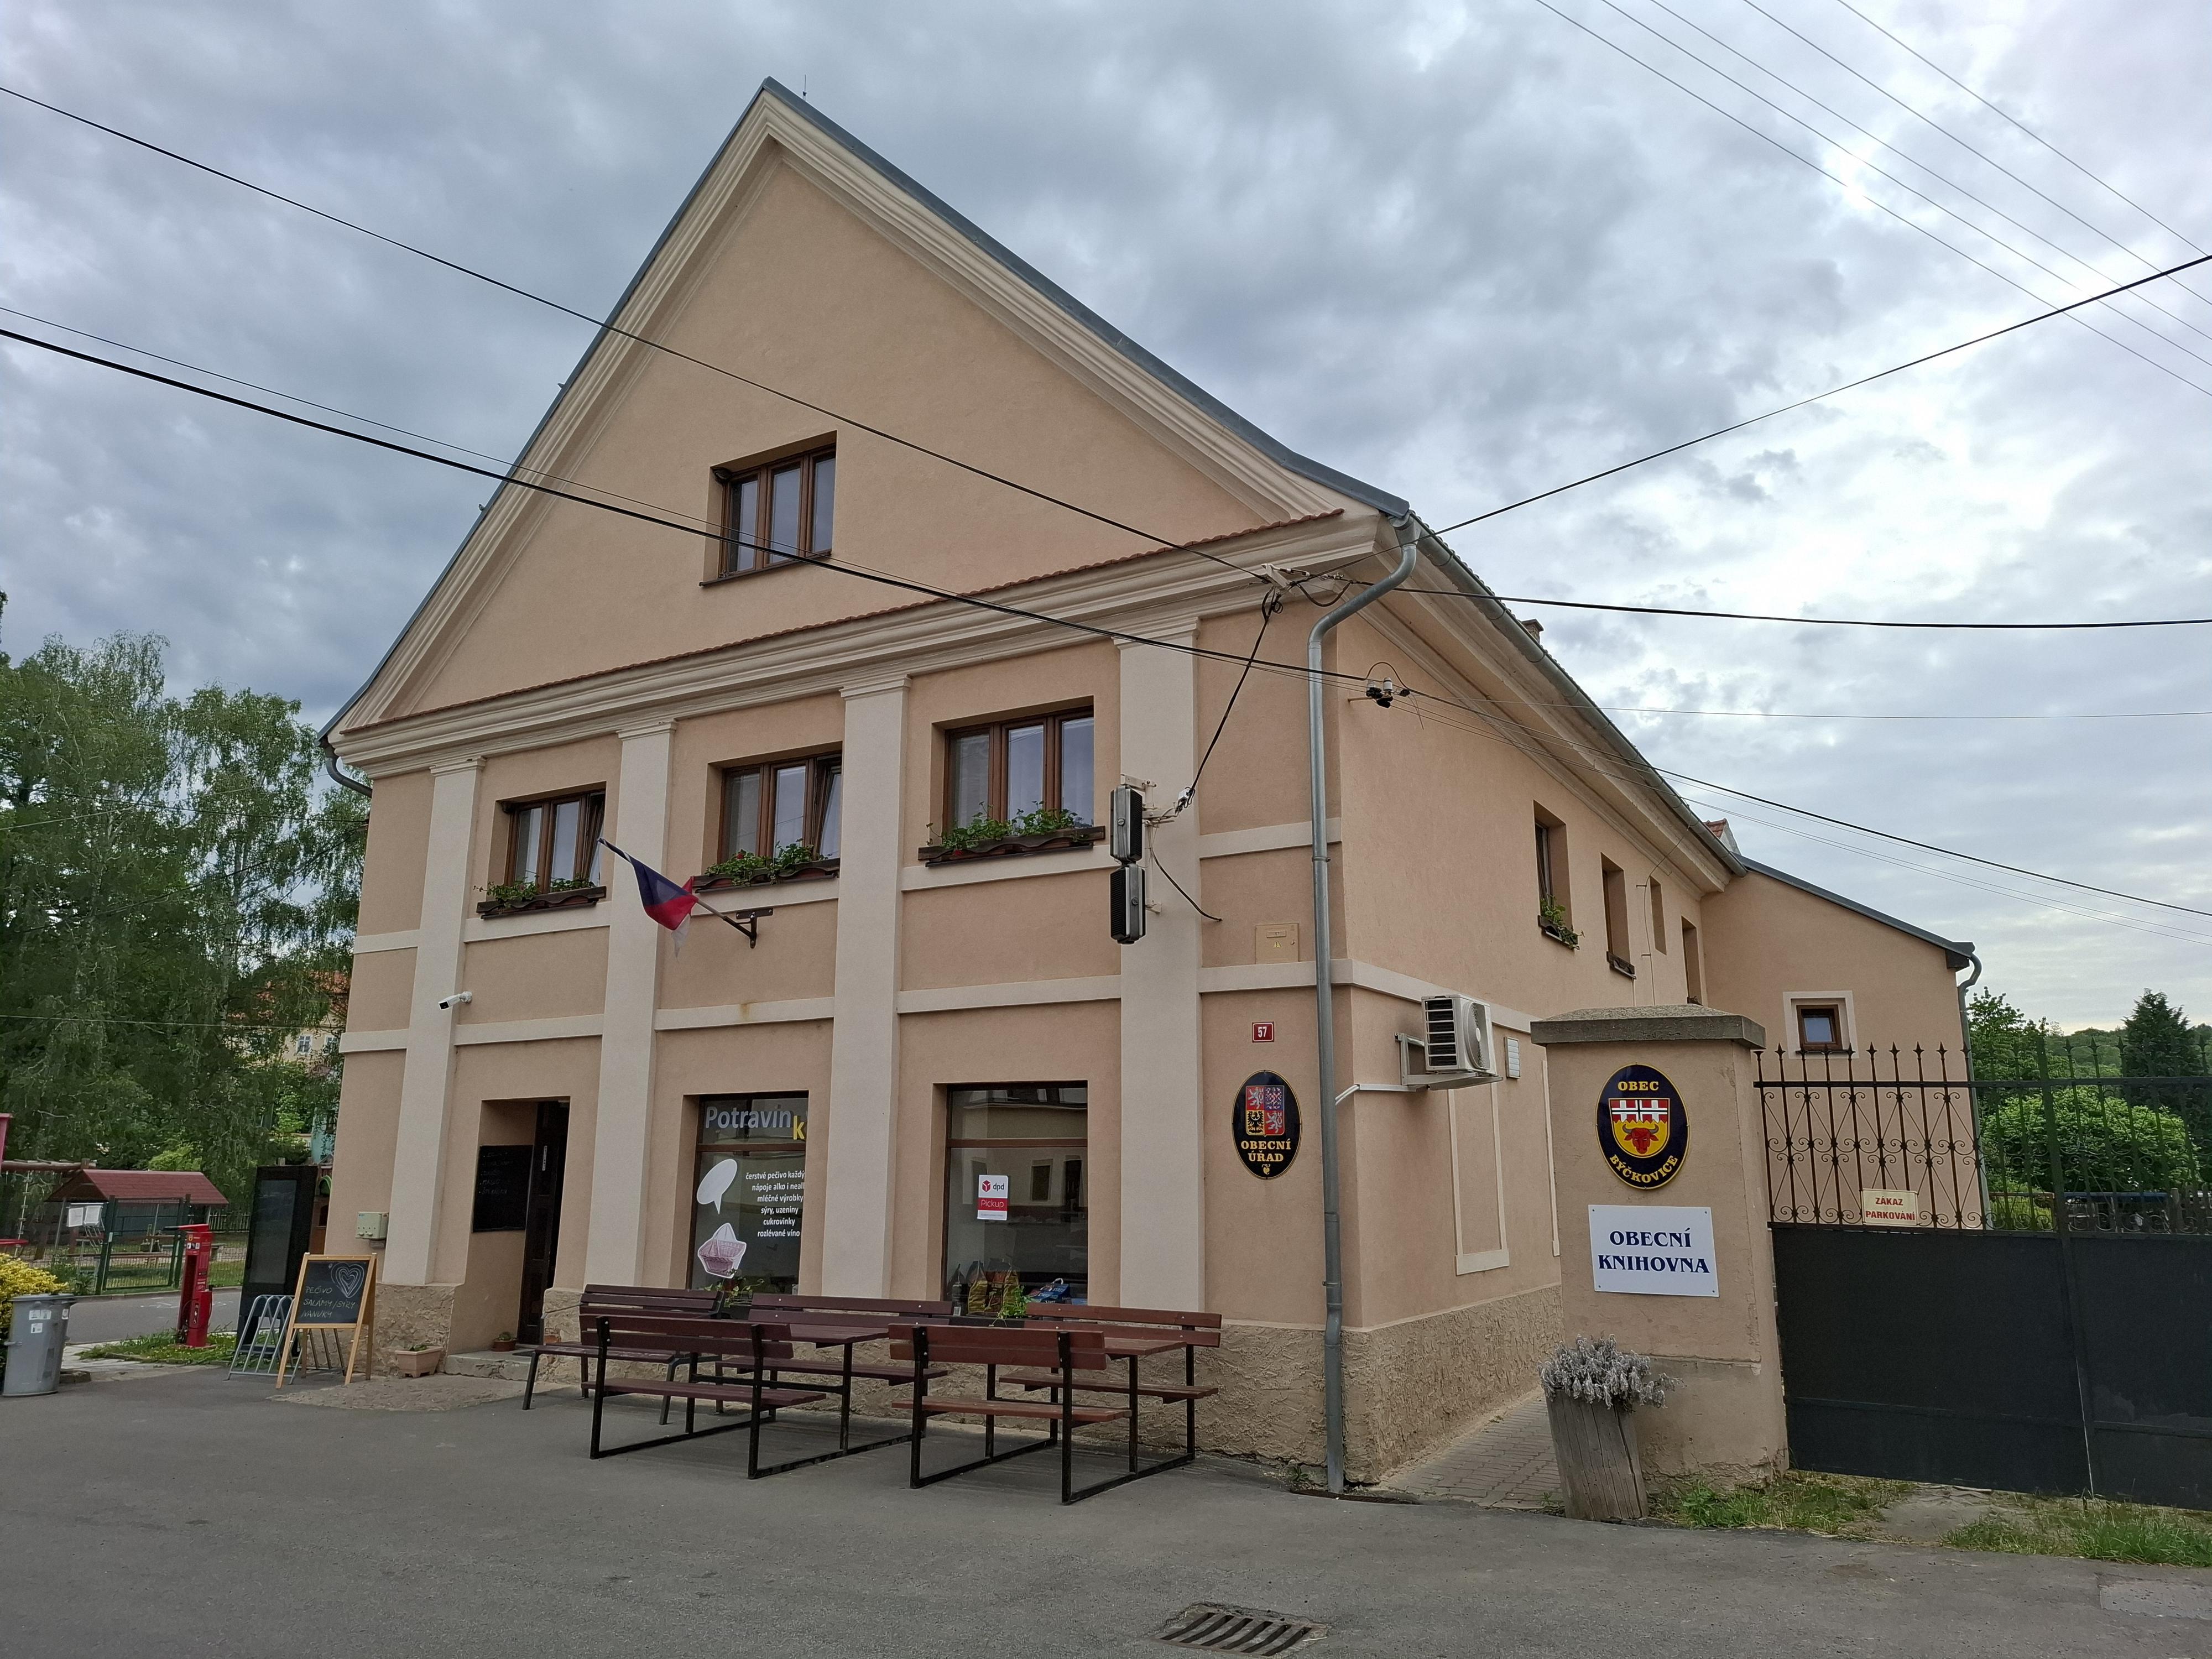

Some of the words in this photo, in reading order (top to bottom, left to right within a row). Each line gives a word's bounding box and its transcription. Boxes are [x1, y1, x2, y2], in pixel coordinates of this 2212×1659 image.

[1258, 1026, 1267, 1038] 57
[1618, 1081, 1659, 1091] OBEC
[1241, 1139, 1291, 1150] OBECNÍ
[1248, 1150, 1284, 1162] ÚŘAD
[1610, 1154, 1678, 1183] BÝČKOVICE
[768, 1171, 786, 1180] pečivo
[788, 1170, 805, 1179] každý
[752, 1183, 772, 1192] nápoje
[993, 1182, 1005, 1191] dpd
[780, 1194, 804, 1203] výrobky
[1875, 1196, 1903, 1206] ZÁKAZ
[981, 1199, 1004, 1209] Pickup
[761, 1206, 774, 1215] sýry,
[776, 1206, 799, 1215] uzeniny
[1865, 1211, 1916, 1220] PARKOVÁNÍ
[763, 1217, 795, 1227] cukrovinky
[757, 1229, 786, 1237] rozlévané
[787, 1229, 800, 1237] víno
[1610, 1227, 1692, 1248] OBECNÍ
[1598, 1255, 1710, 1273] KNIHOVNA
